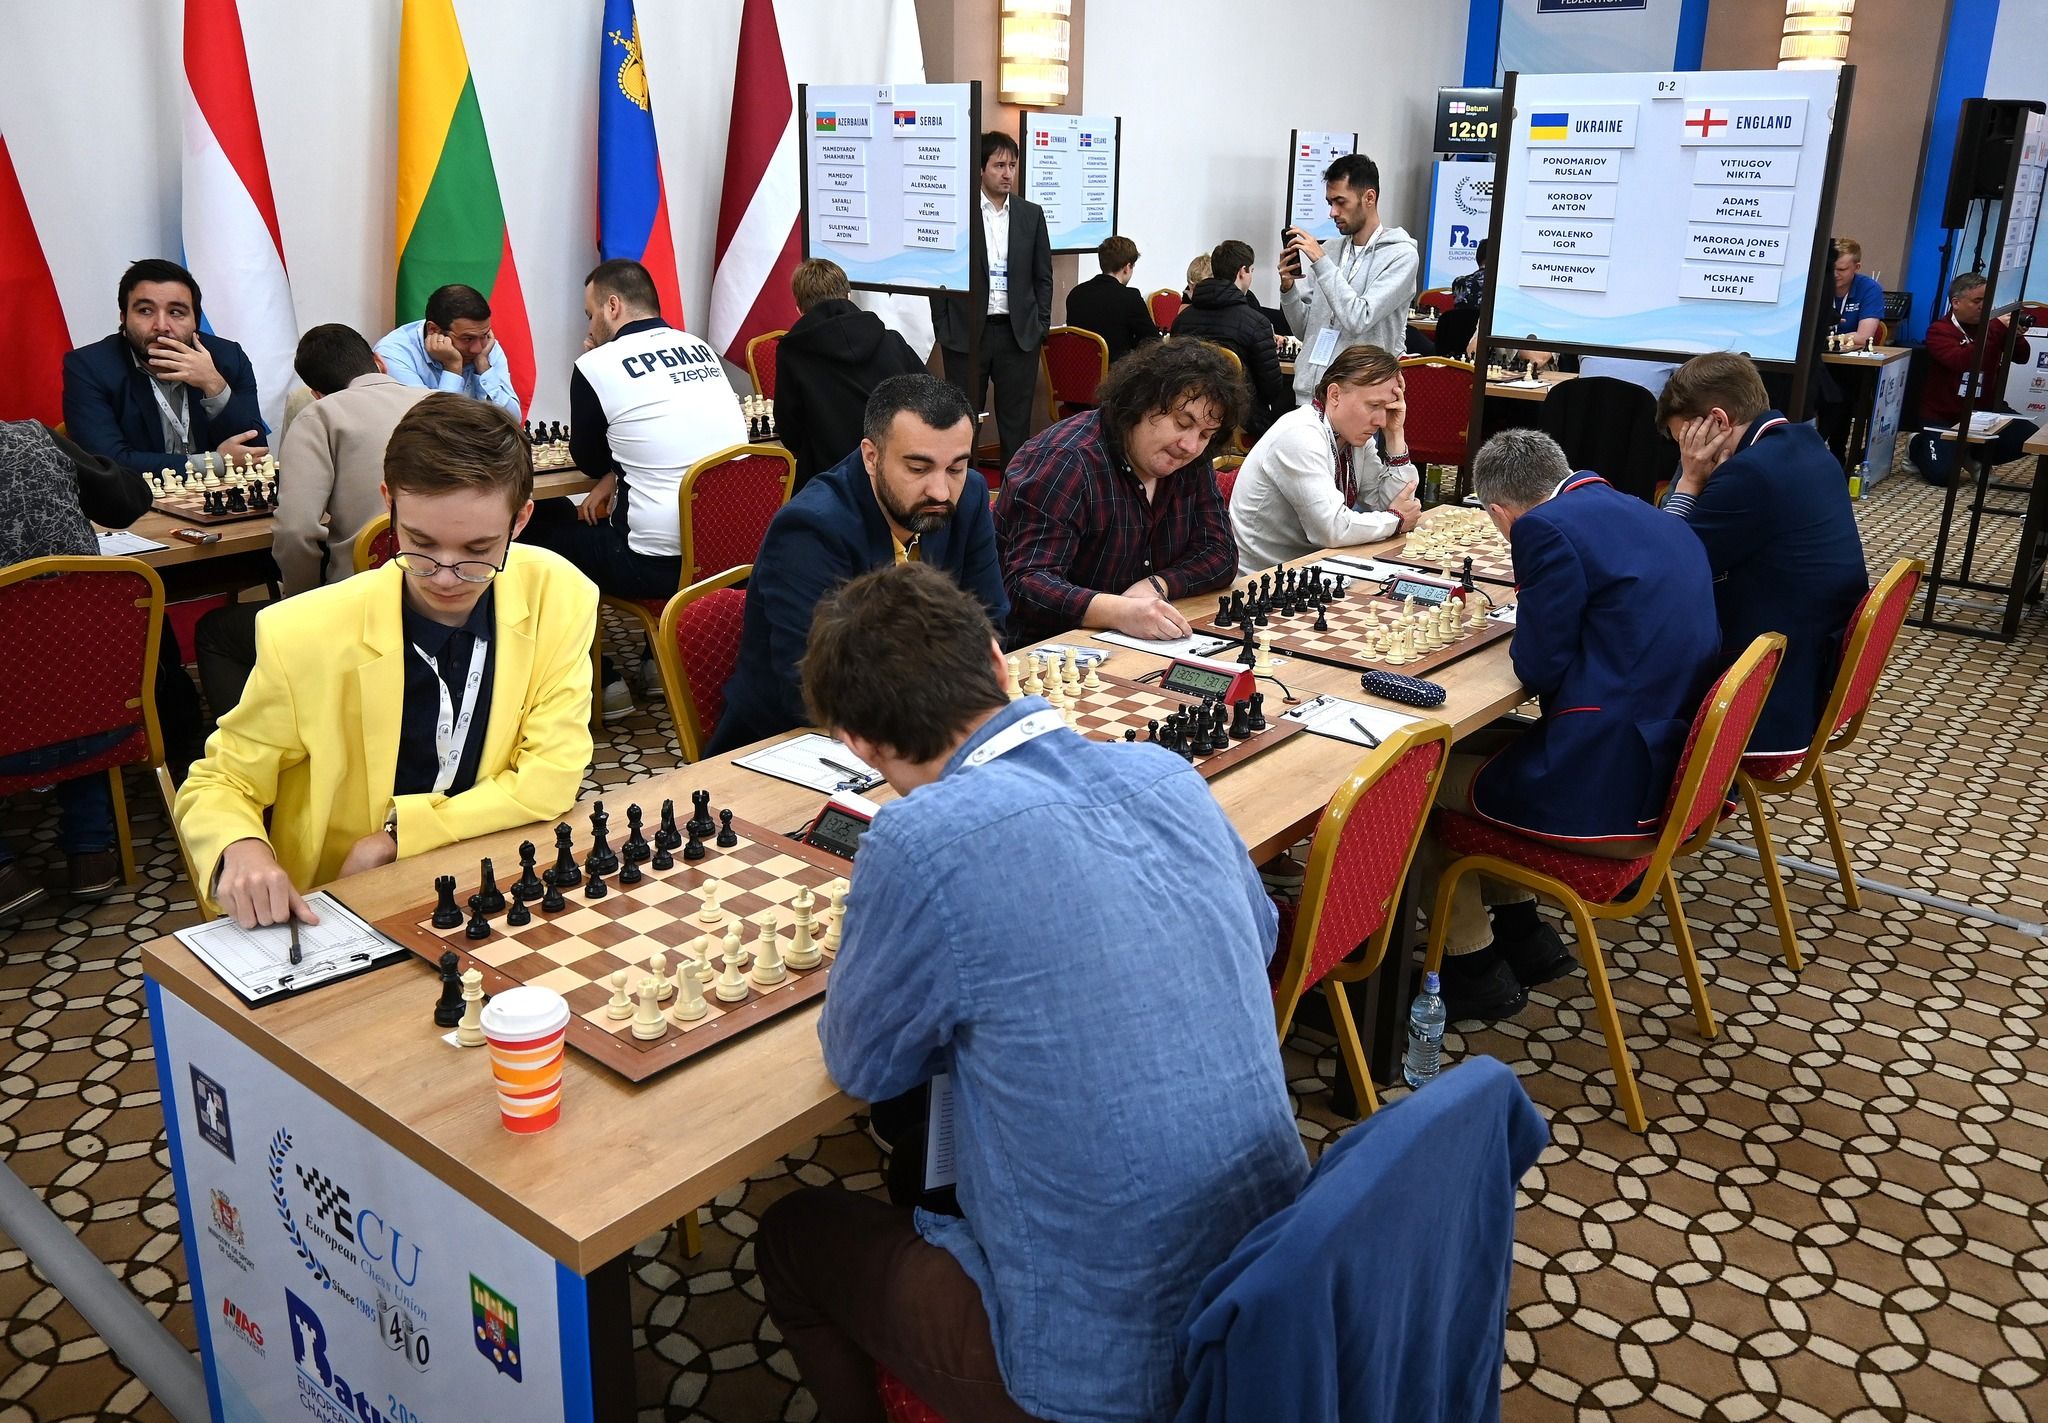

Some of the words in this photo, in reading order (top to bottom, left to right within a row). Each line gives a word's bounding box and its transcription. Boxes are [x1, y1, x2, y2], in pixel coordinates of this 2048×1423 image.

[1658, 81, 1676, 92] 0-2
[879, 90, 888, 98] 0-1
[920, 116, 943, 126] SERBIA
[1736, 116, 1792, 129] ENGLAND
[1449, 122, 1497, 138] 12:01
[1575, 120, 1623, 133] UKRAINE
[1543, 157, 1607, 166] PONOMARIOV
[1720, 159, 1772, 168] VITIUGOV
[1554, 167, 1592, 176] RUSLAN
[1726, 170, 1762, 179] NIKITA
[911, 182, 947, 190] ALEKSANDAR
[1547, 192, 1593, 201] KOROBOV
[1722, 197, 1759, 206] ADAMS
[1552, 203, 1586, 212] ANTON
[1715, 208, 1763, 218] MICHAEL
[917, 228, 940, 236] MARKUS
[1538, 229, 1593, 239] KOVALENKO
[1553, 240, 1576, 249] IGOR
[1693, 235, 1745, 246] MAROROA
[1746, 238, 1780, 248] JONES
[1703, 246, 1746, 257] GAWAIN
[1748, 249, 1756, 258] C
[1759, 249, 1765, 258] B
[1531, 263, 1596, 275] SAMUNENKOV
[1550, 275, 1574, 283] IHOR
[1703, 273, 1754, 283] MCSHANE
[1711, 285, 1737, 294] LUKE
[1739, 286, 1744, 295] J
[305, 1213, 357, 1266] European
[360, 1258, 392, 1293] Chess
[394, 1284, 428, 1322] Union
